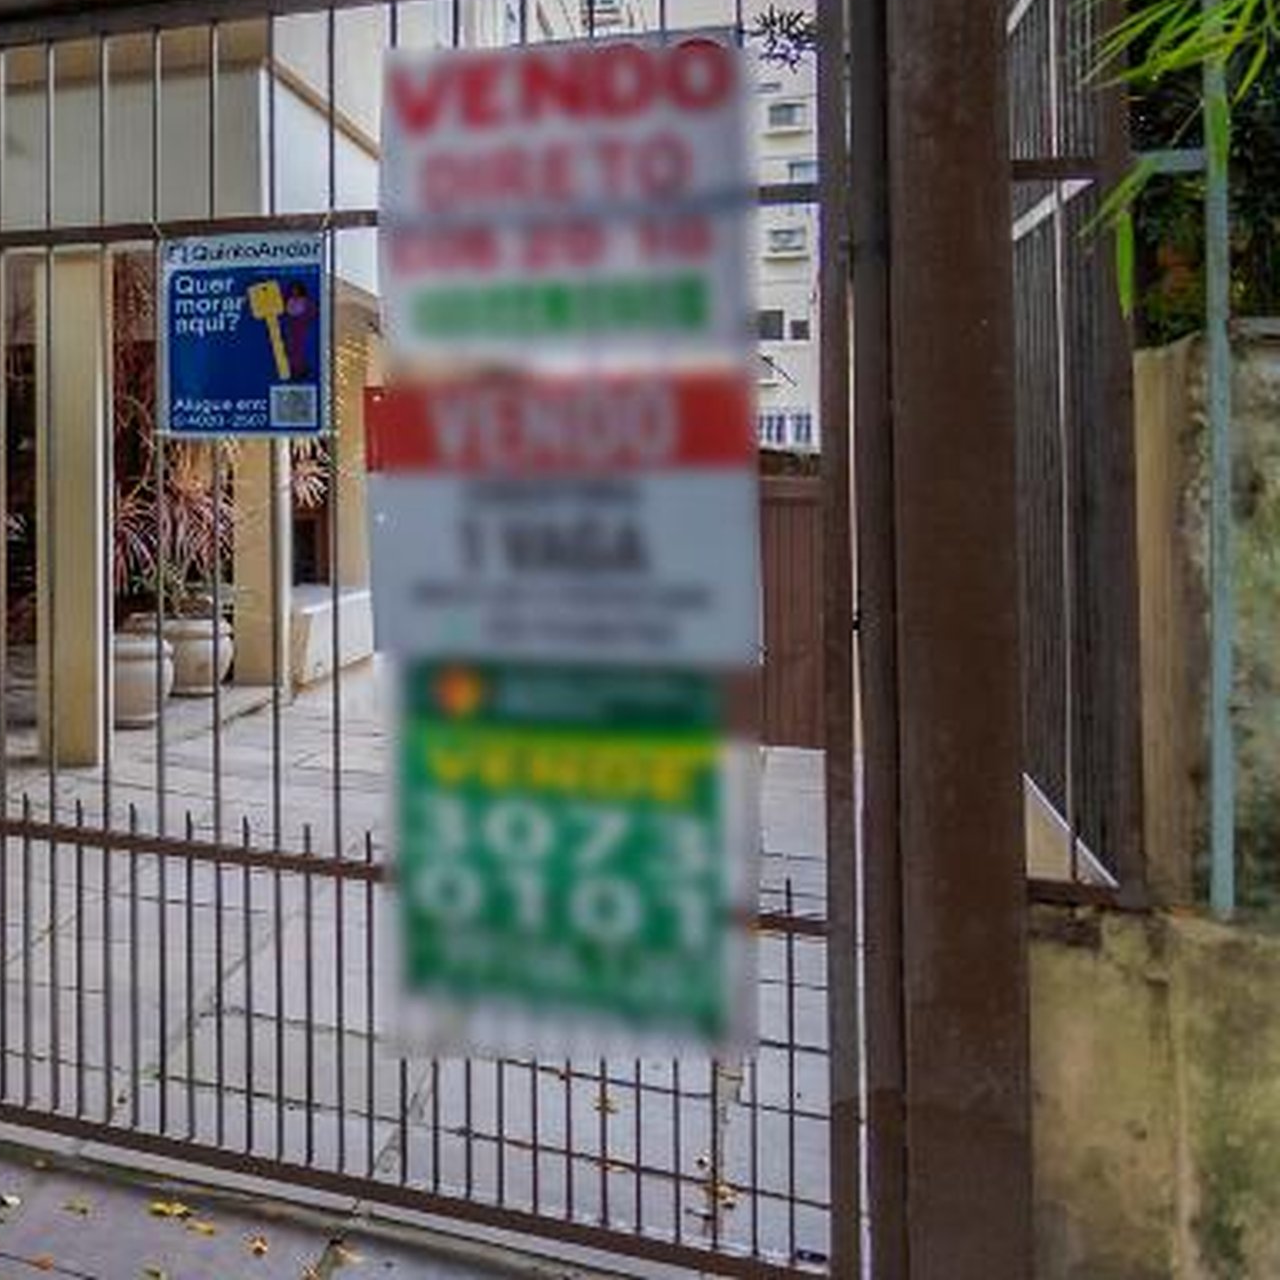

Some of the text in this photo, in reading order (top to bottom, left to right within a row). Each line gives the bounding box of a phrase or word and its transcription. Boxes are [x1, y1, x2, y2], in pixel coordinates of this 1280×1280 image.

[386, 37, 735, 135] VENDO
[192, 241, 321, 262] QuintoAndar
[174, 274, 234, 295] Quer
[174, 297, 244, 315] morar
[174, 313, 241, 337] aqui?
[428, 382, 679, 462] VENDO
